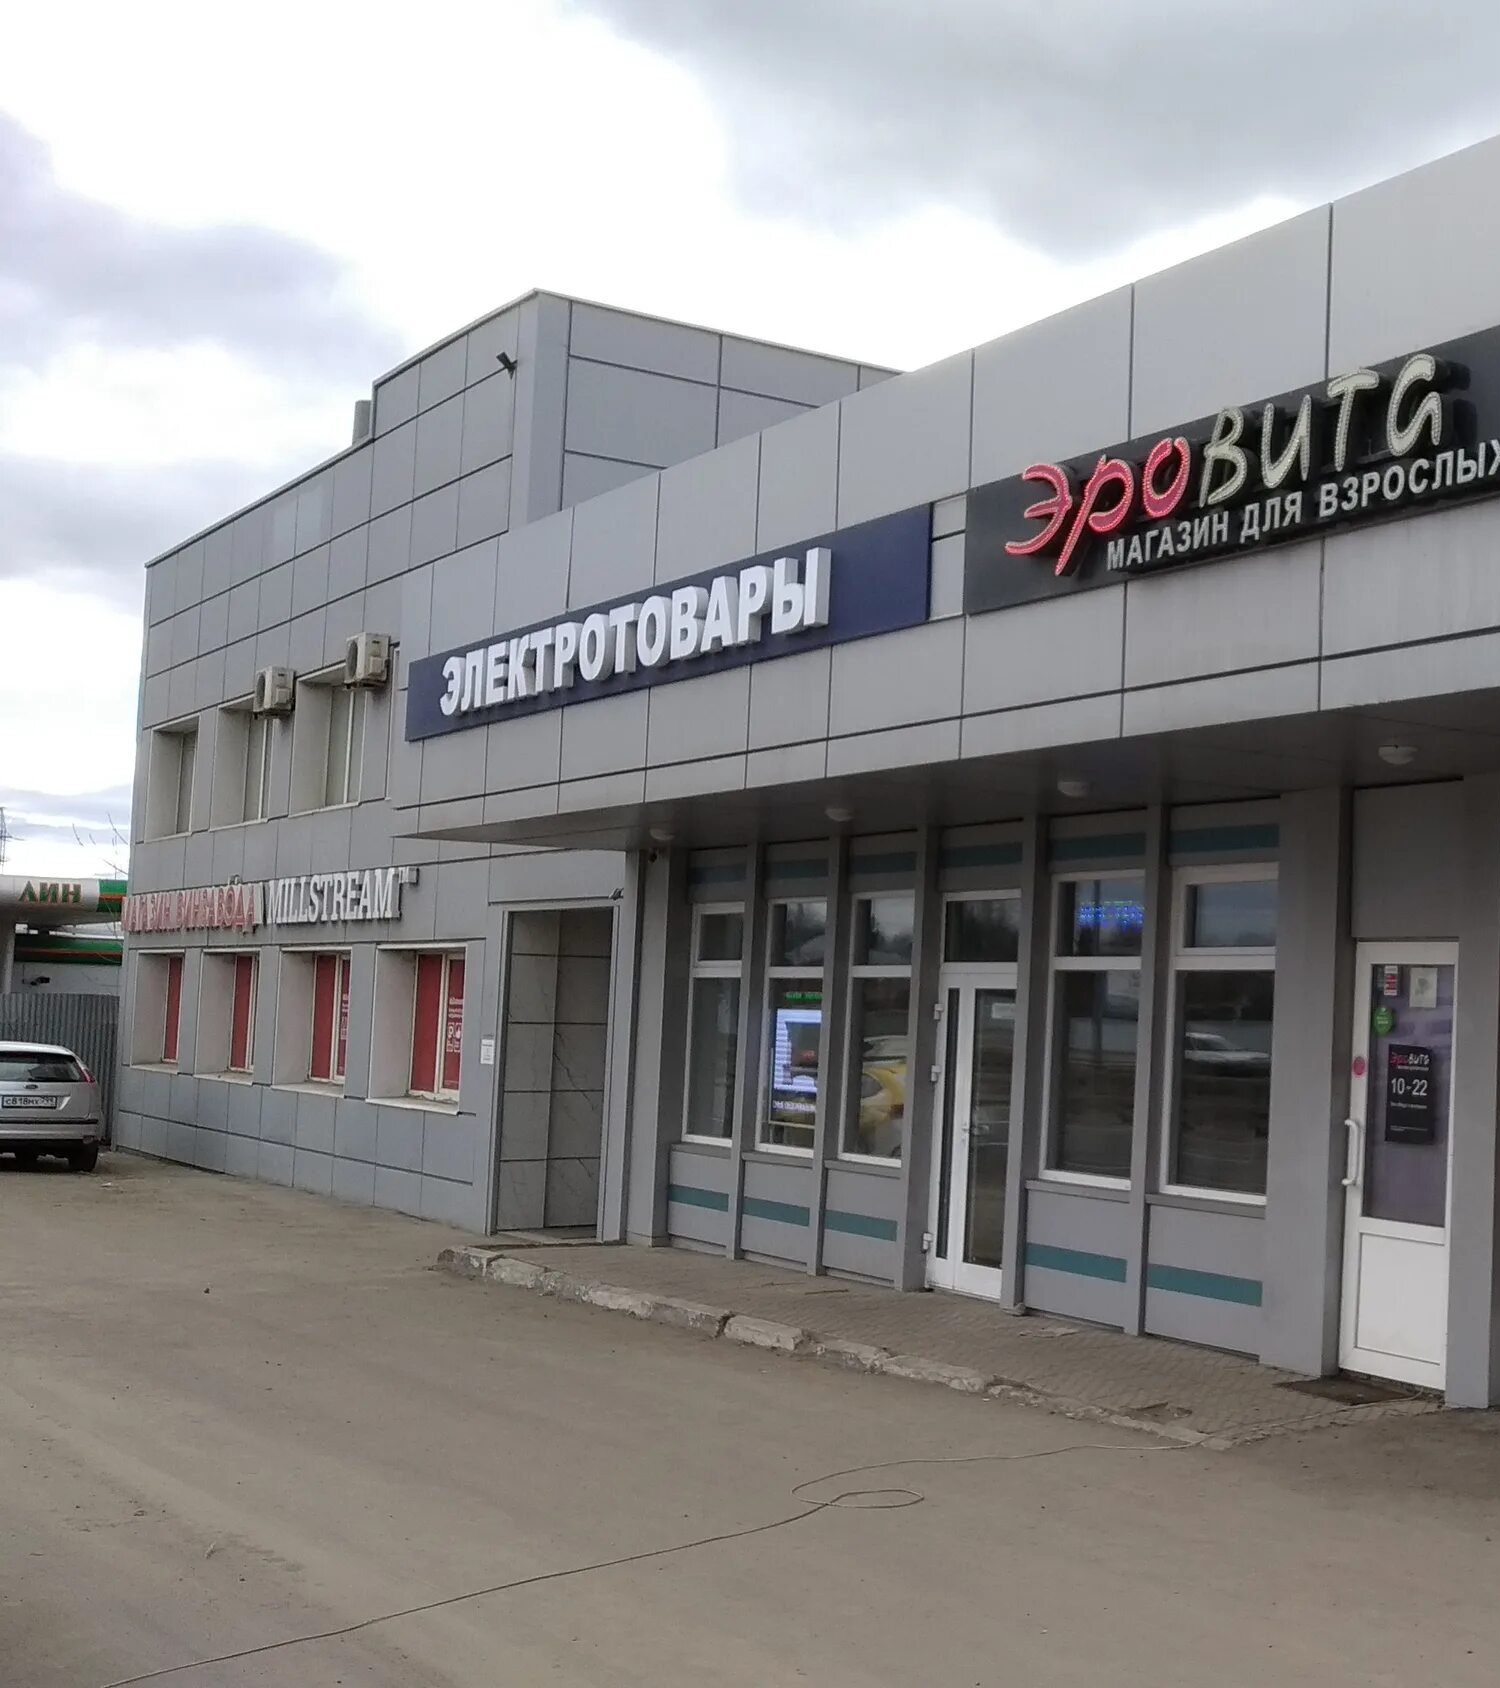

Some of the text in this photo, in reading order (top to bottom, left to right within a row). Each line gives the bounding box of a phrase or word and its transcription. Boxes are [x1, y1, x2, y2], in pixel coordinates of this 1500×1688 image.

[1107, 514, 1229, 571] МАГАЗИН
[1240, 490, 1302, 545] ДЛЯ
[439, 547, 832, 716] ЭЛЕКТРОТОВАРЫ
[266, 868, 399, 924] MILLSTREAM
